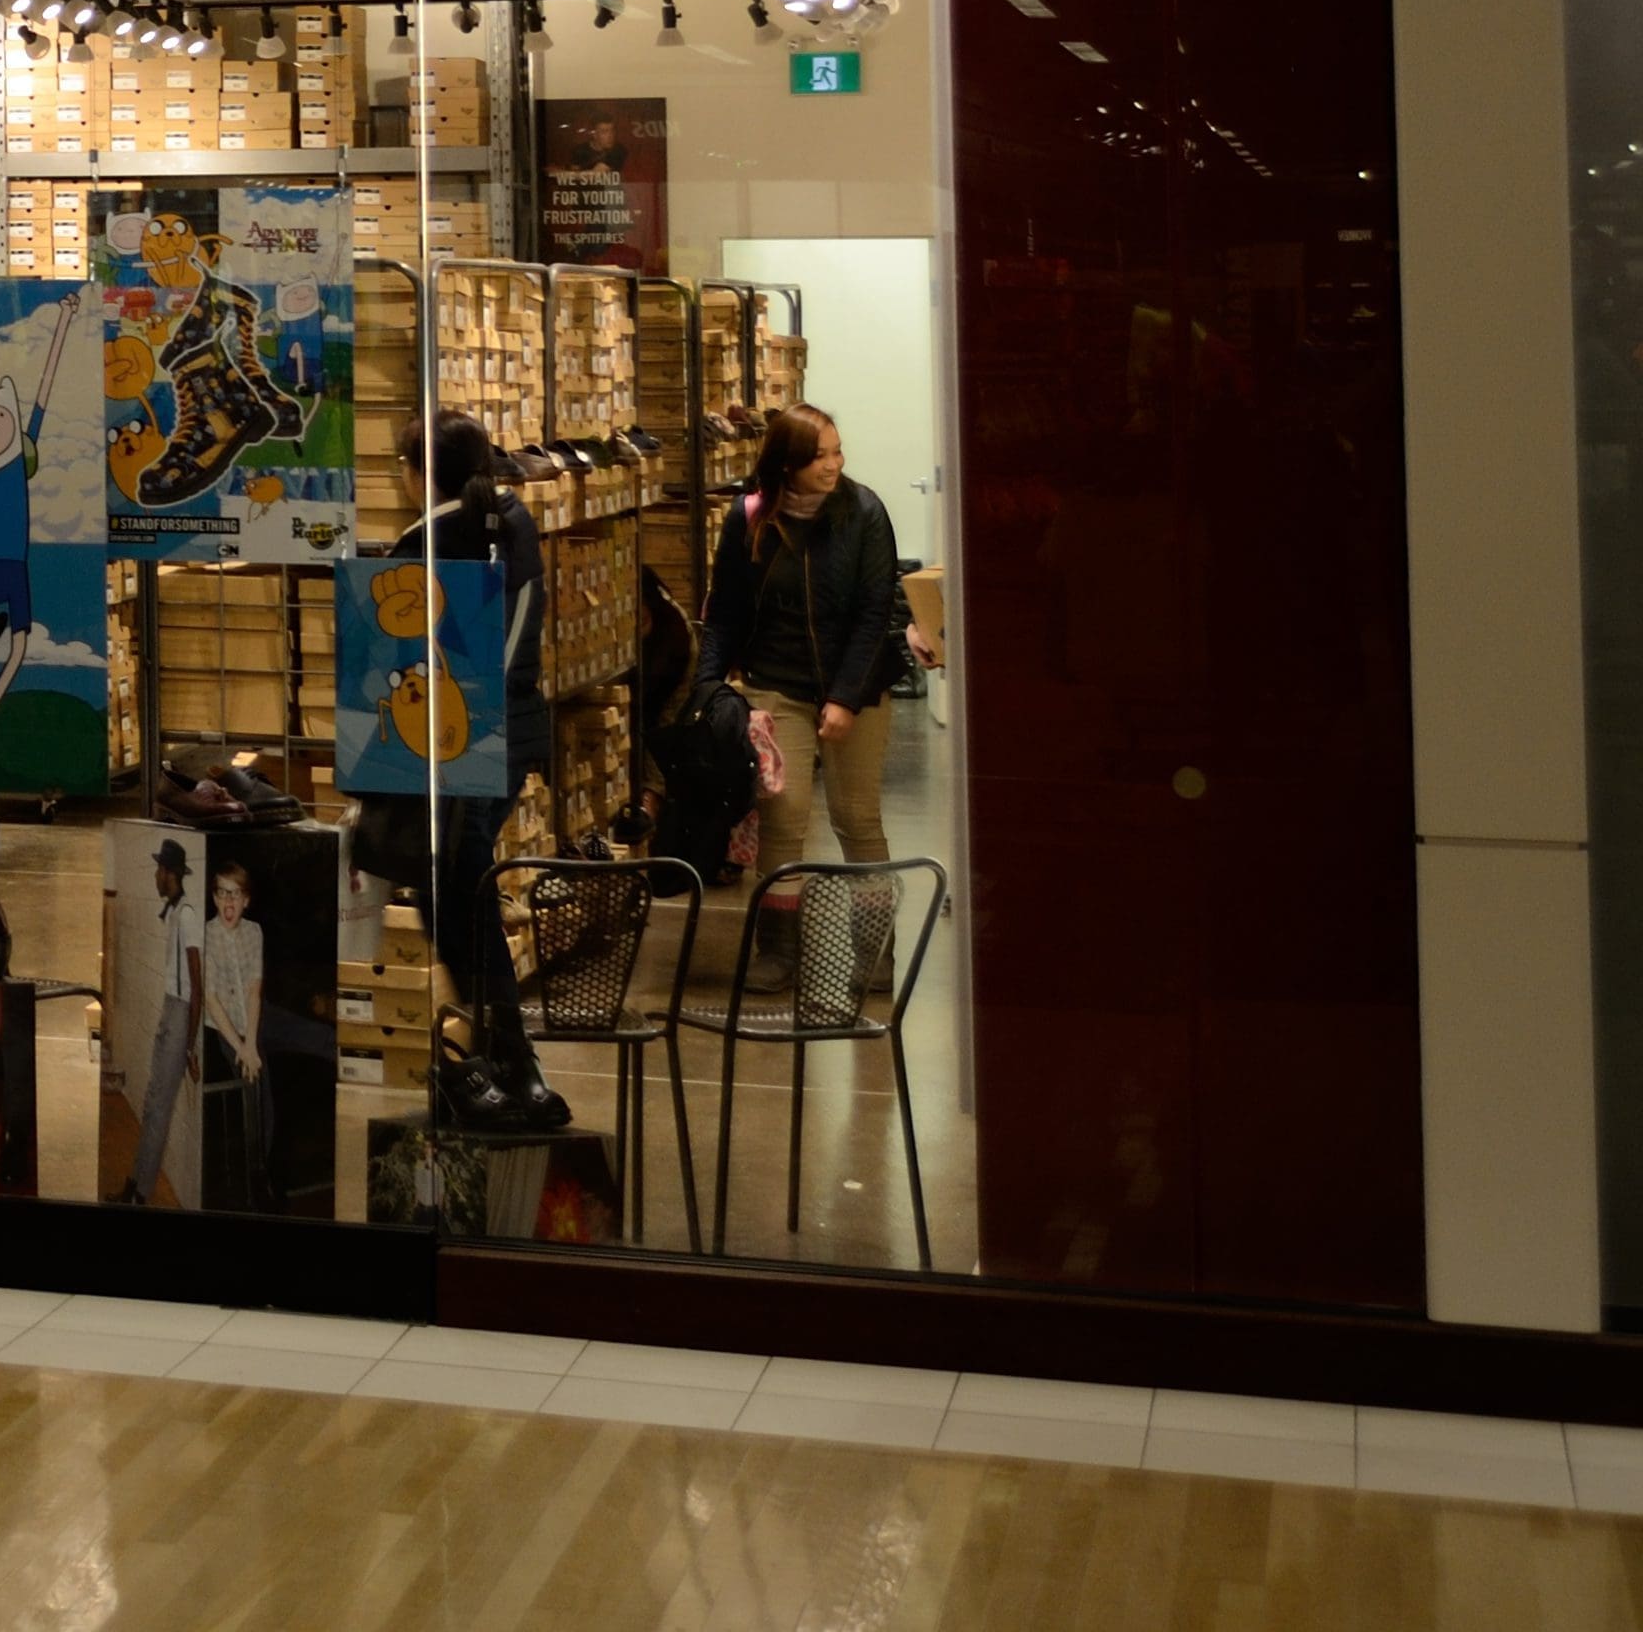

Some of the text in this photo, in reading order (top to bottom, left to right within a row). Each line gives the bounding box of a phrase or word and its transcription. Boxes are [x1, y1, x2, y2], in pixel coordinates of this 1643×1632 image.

[580, 171, 621, 186] STAND
[552, 190, 625, 206] FOR YOUTH
[553, 233, 625, 244] THE SPITFIRES
